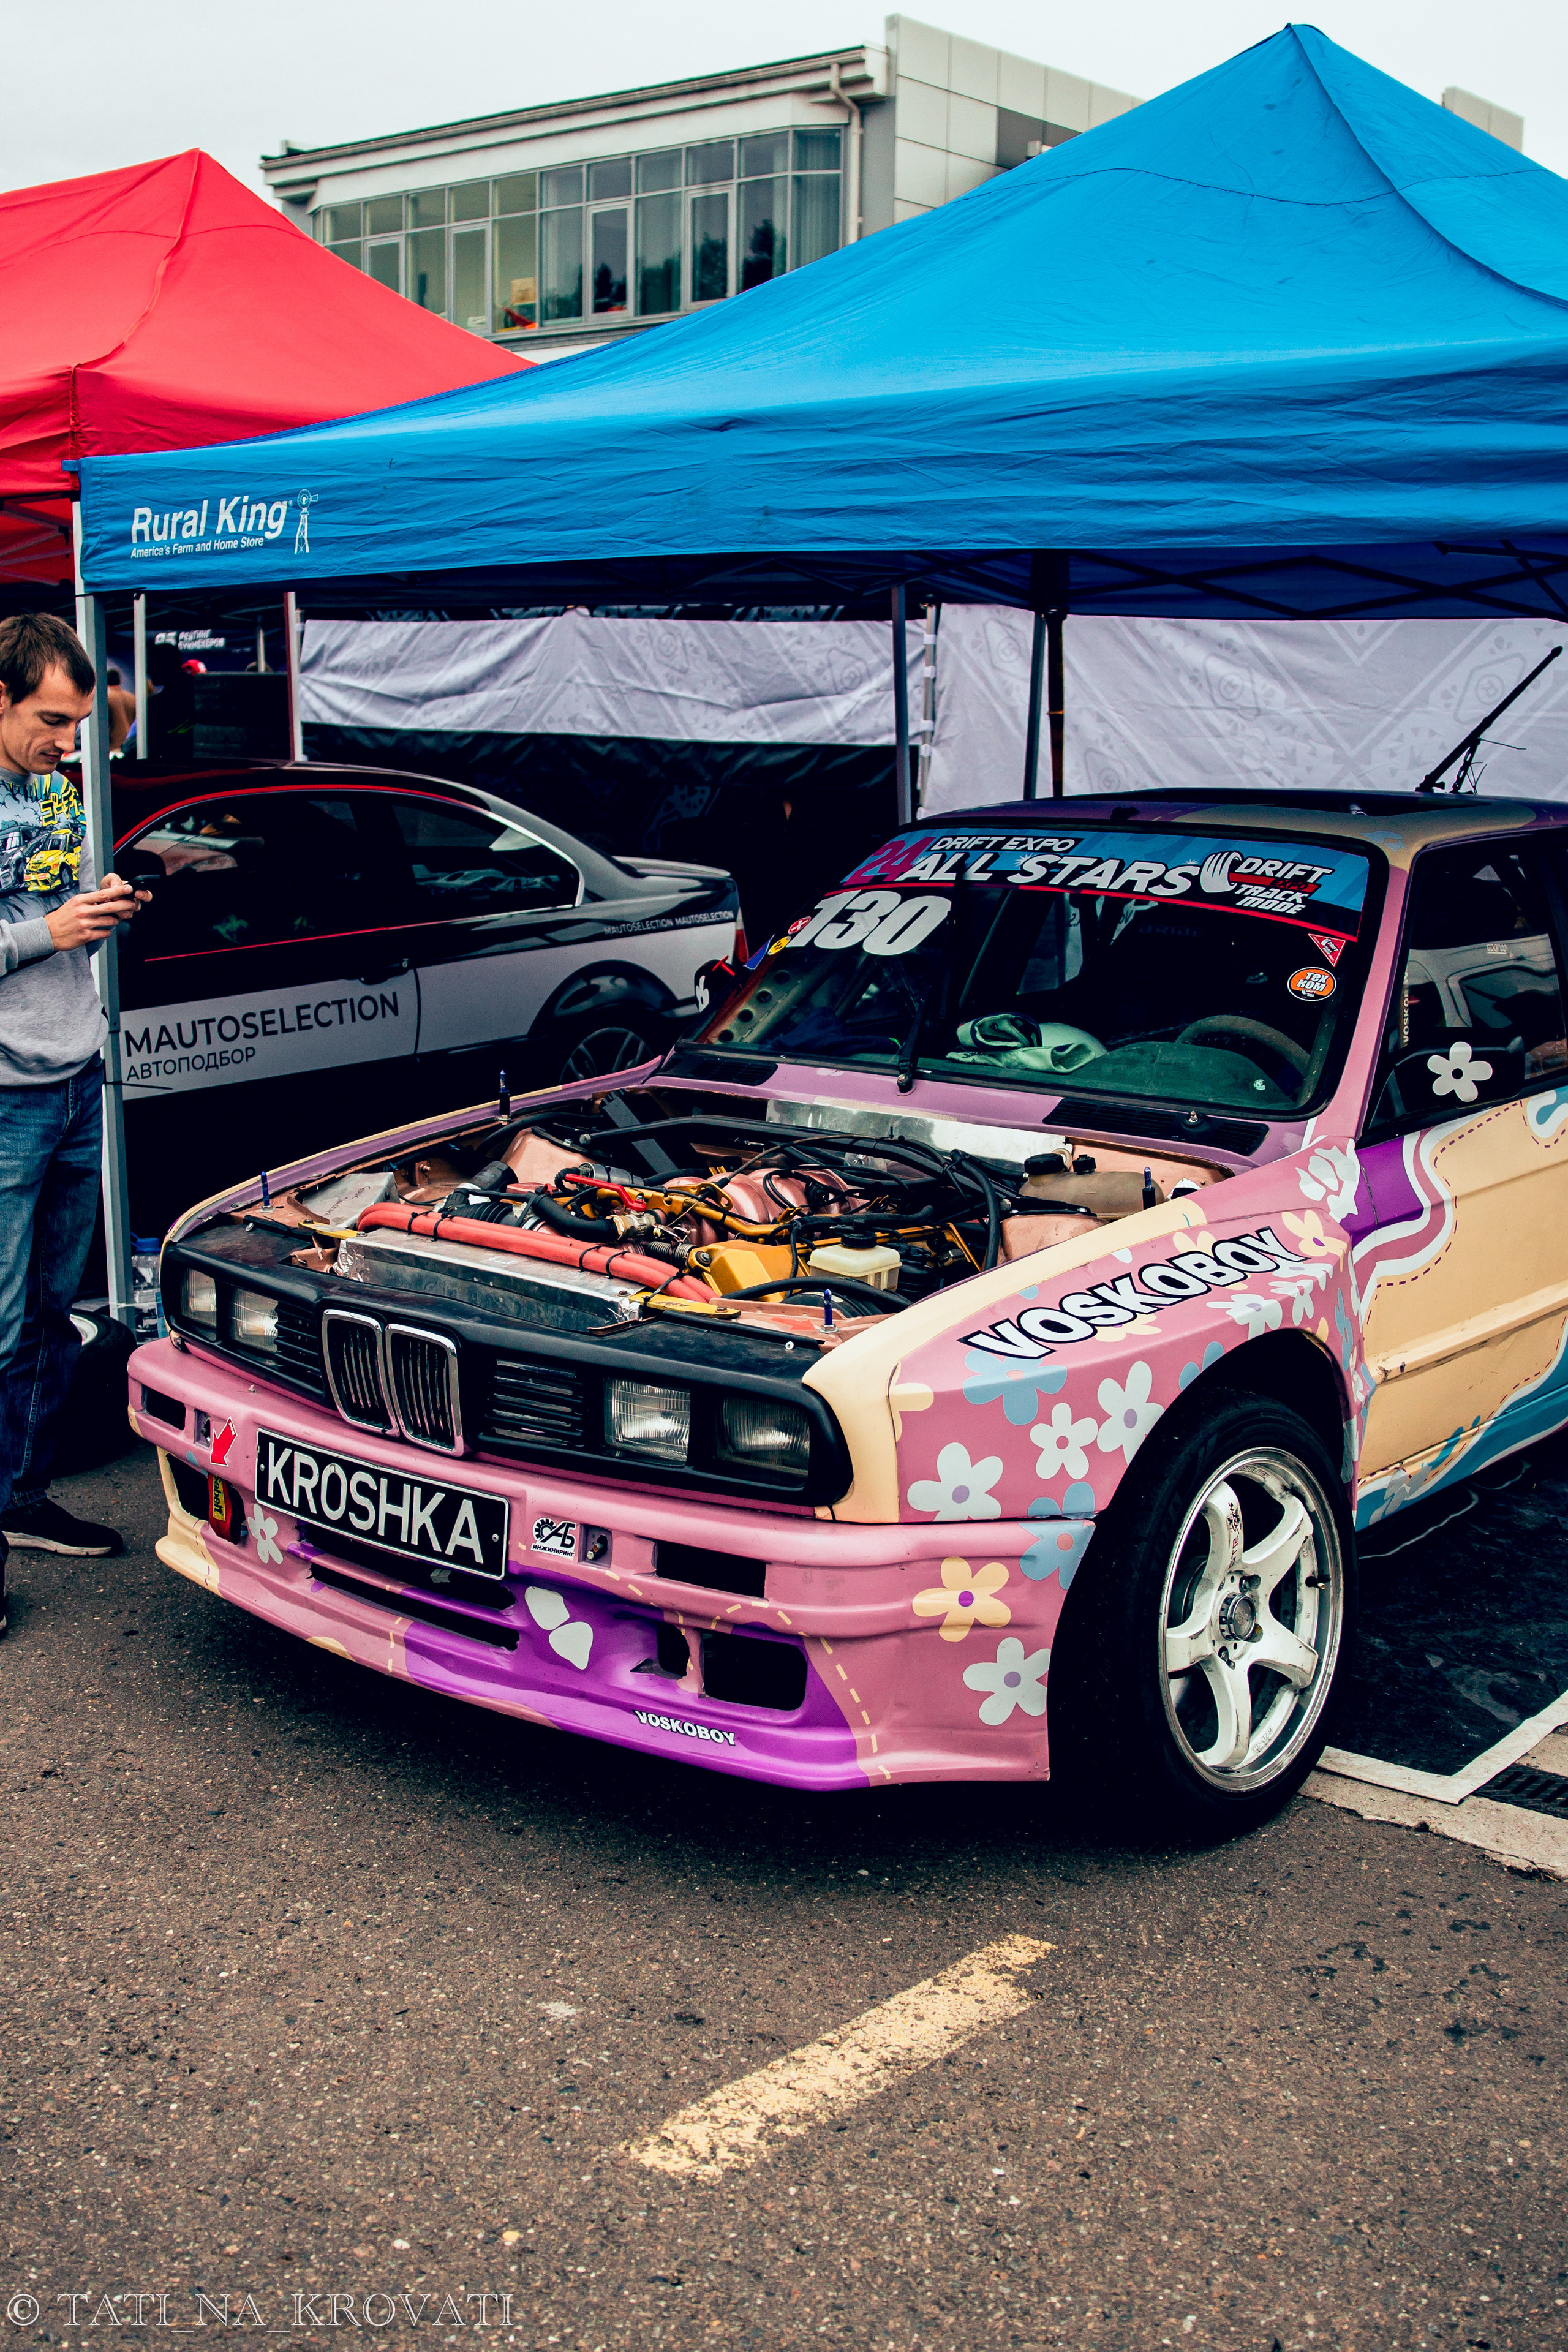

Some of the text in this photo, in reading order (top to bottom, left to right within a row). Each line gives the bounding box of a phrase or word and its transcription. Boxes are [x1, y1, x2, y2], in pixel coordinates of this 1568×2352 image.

[130, 495, 288, 544] Rural King
[130, 535, 264, 559] America's Farm and Home Store
[842, 835, 937, 886] 24
[930, 836, 1076, 852] DRIFT EXPO
[894, 853, 1200, 896] ALL STARS
[1234, 857, 1333, 883] DRIFT
[1269, 878, 1309, 891] EXPO
[1234, 884, 1310, 904] TRACK
[1235, 895, 1307, 914] MODE
[674, 910, 734, 925] MAUTOSELECTION
[786, 890, 951, 957] 130
[124, 991, 399, 1058] MAUTOSELECTION
[126, 1046, 256, 1082] АВТОПОДБОР
[958, 1227, 1309, 1359] VOSKOBOY
[268, 1442, 484, 1564] KROSHKA
[532, 1544, 575, 1557] ИНЖИНИРИНГ
[633, 1709, 736, 1746] VOSKOBOY
